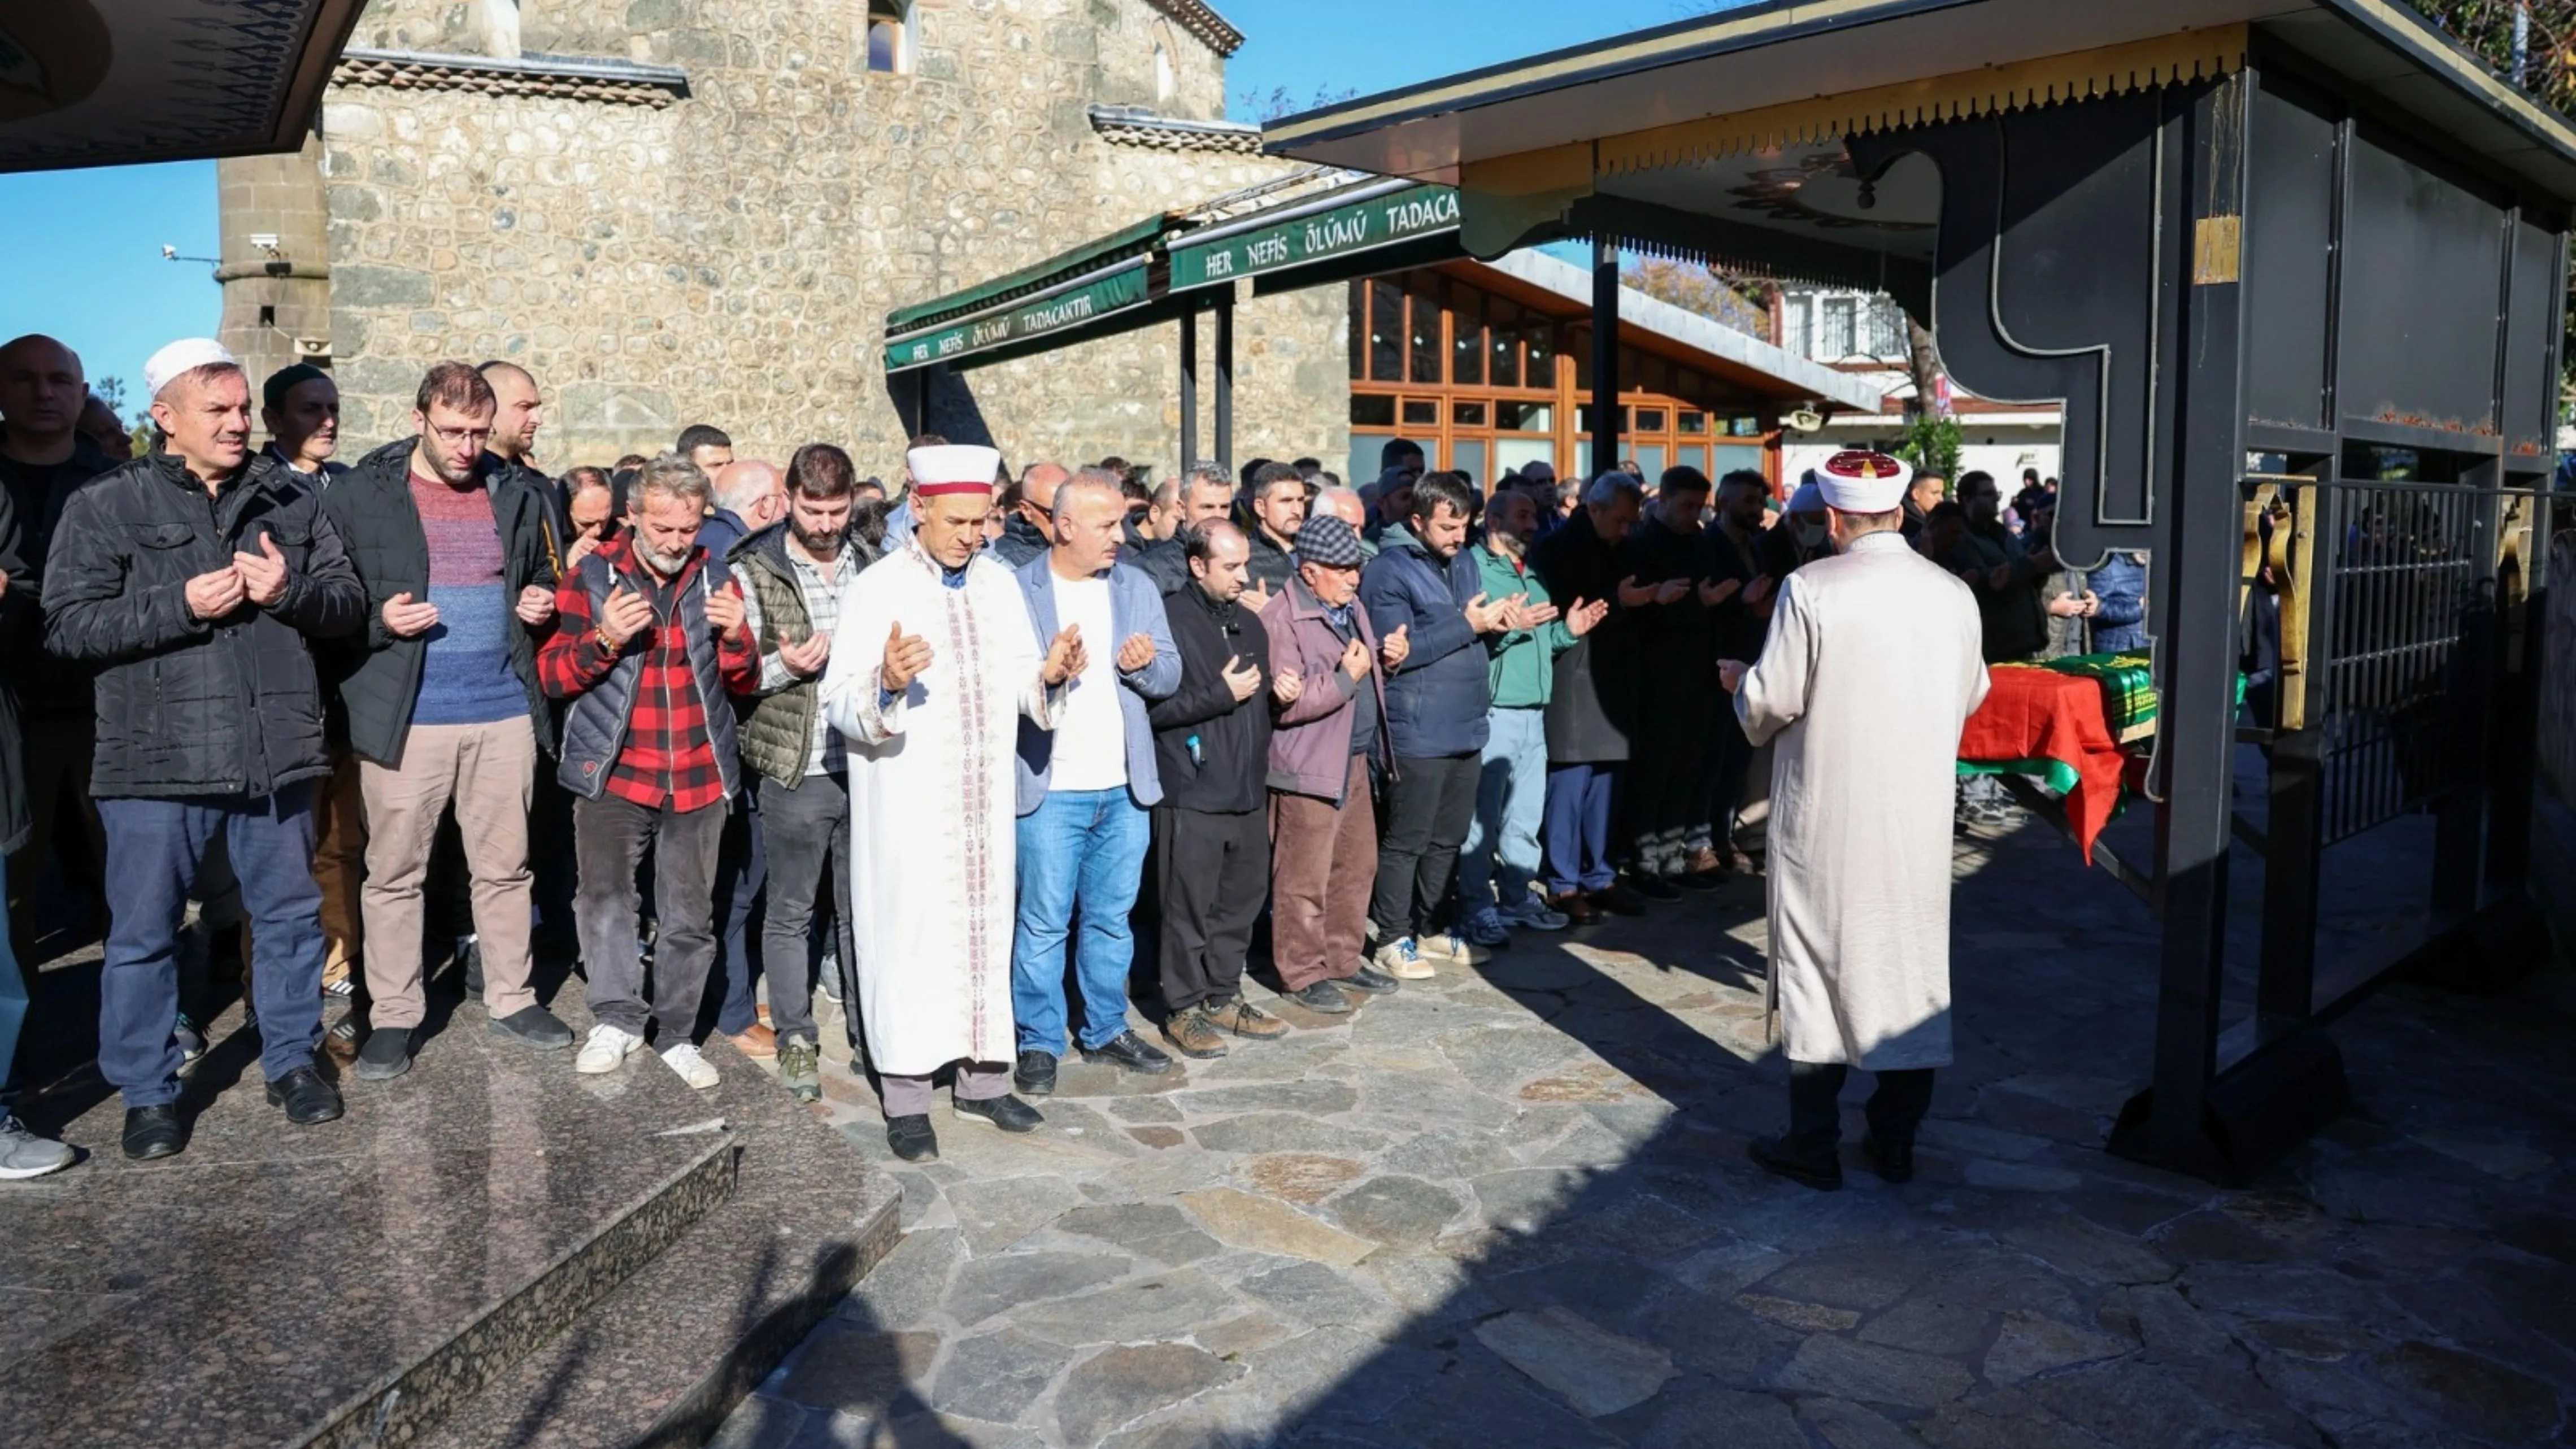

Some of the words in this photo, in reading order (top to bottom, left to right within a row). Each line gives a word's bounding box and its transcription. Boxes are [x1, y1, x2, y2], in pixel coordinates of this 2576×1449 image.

[1206, 250, 1233, 277] HER
[1246, 232, 1287, 267] NEFİS
[1305, 209, 1368, 254] ÖLÜMÜ
[1386, 193, 1460, 234] TADACA
[912, 343, 929, 361] HER
[938, 331, 964, 355] NEFİS
[1022, 294, 1093, 333] TADACAKTIR
